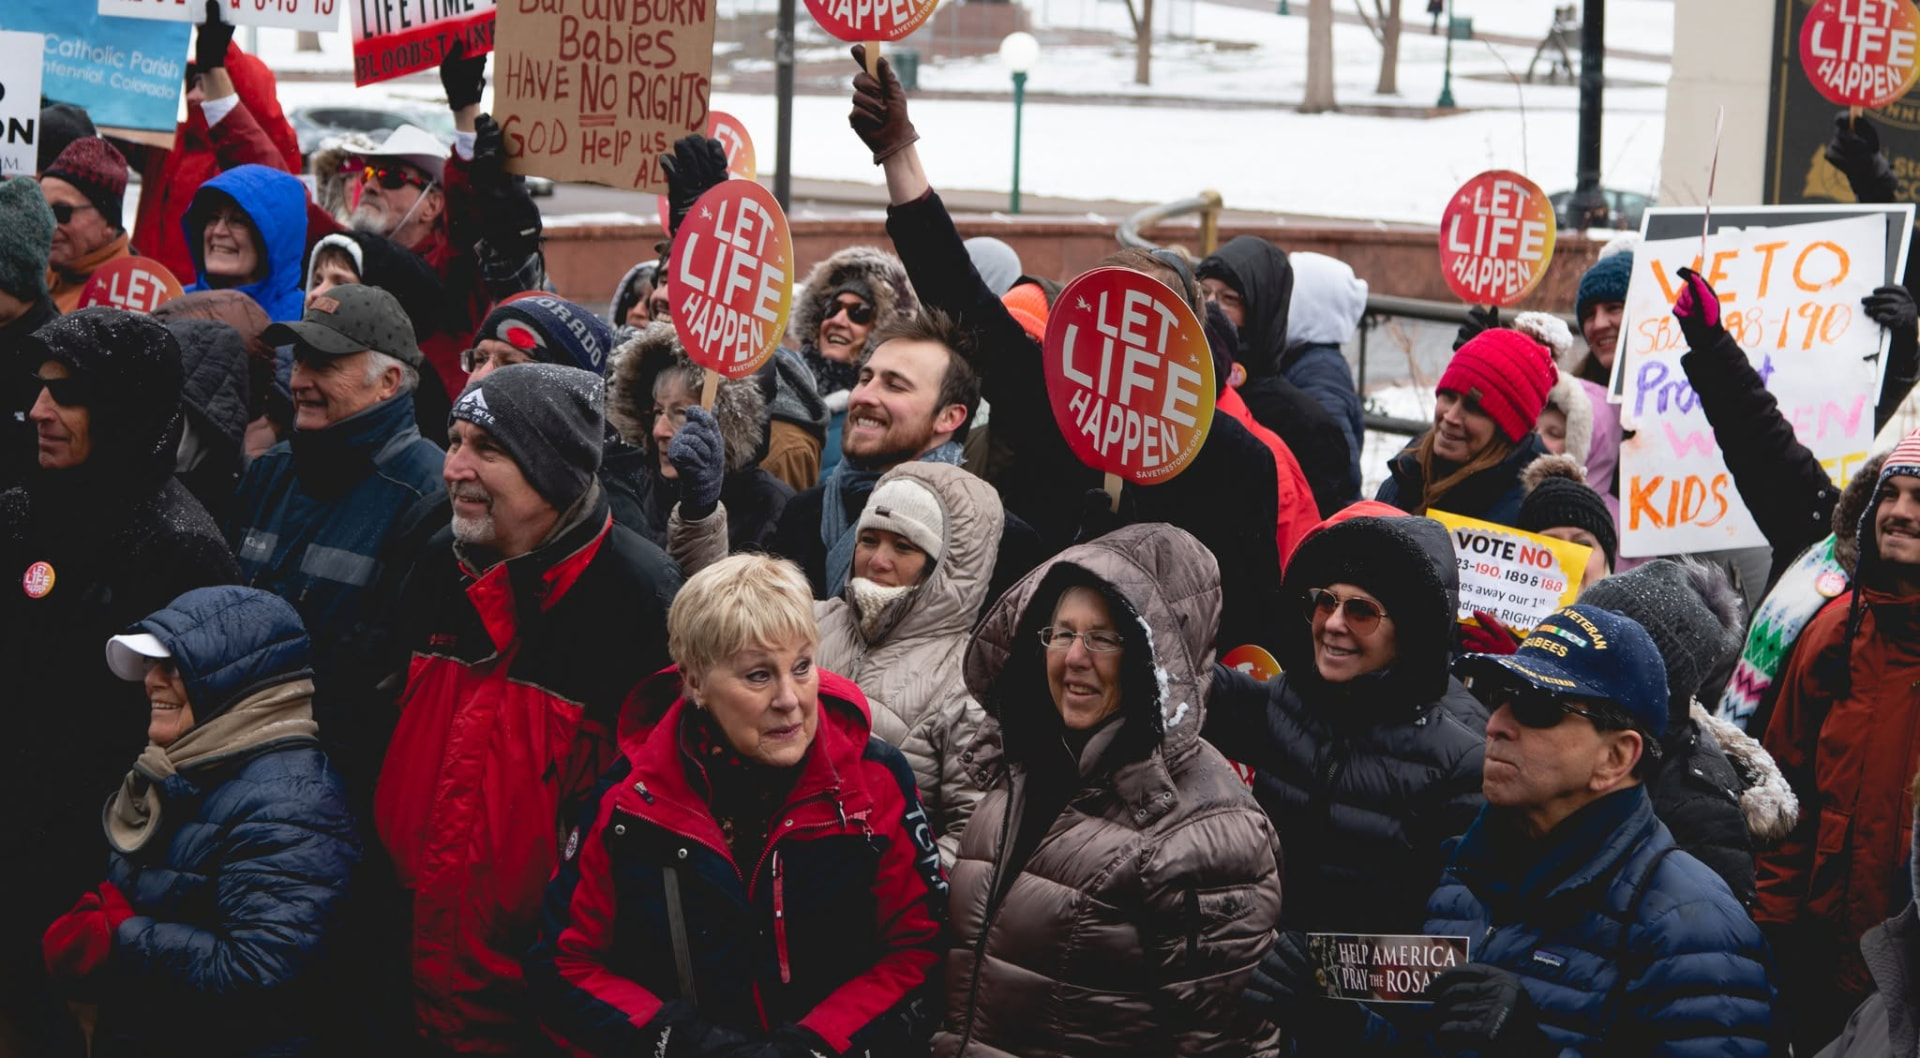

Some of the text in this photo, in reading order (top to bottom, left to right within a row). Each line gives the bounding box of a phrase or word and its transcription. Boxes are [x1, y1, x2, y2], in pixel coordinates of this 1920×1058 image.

[1838, 0, 1899, 28] LET
[43, 33, 180, 80] Catholic Parish
[559, 15, 676, 69] Babies
[1811, 20, 1917, 67] LIFE
[110, 72, 175, 99] Colorado
[505, 51, 708, 132] HAVE NO RIGHTS
[1817, 59, 1903, 100] HAPPEN
[504, 114, 567, 158] GOD
[714, 123, 743, 168] ET
[634, 154, 668, 189] AL
[1473, 180, 1530, 219] LET
[714, 197, 774, 256] LET
[1448, 214, 1547, 261] LIFE
[109, 268, 167, 313] LET
[680, 232, 784, 323] LIFE
[1452, 254, 1531, 298] HAPPEN
[1650, 241, 1850, 305] VETO
[533, 298, 602, 367] ORADO
[681, 292, 764, 363] HAPPEN
[1097, 289, 1179, 354] LET
[1062, 323, 1202, 428] LIFE
[1069, 389, 1179, 468] HAPPEN
[1629, 473, 1728, 530] KIDS
[1457, 531, 1553, 569] VOTE NO
[25, 573, 51, 586] LIFE
[1459, 581, 1474, 593] es
[1476, 585, 1506, 602] away
[1508, 594, 1529, 606] our
[1505, 570, 1529, 584] 189
[1530, 576, 1539, 587] &
[1540, 578, 1563, 592] 188
[1563, 608, 1607, 650] VETERAN
[1338, 943, 1456, 967] HELP AMERICA
[1341, 967, 1442, 993] PRAY THE ROSA
